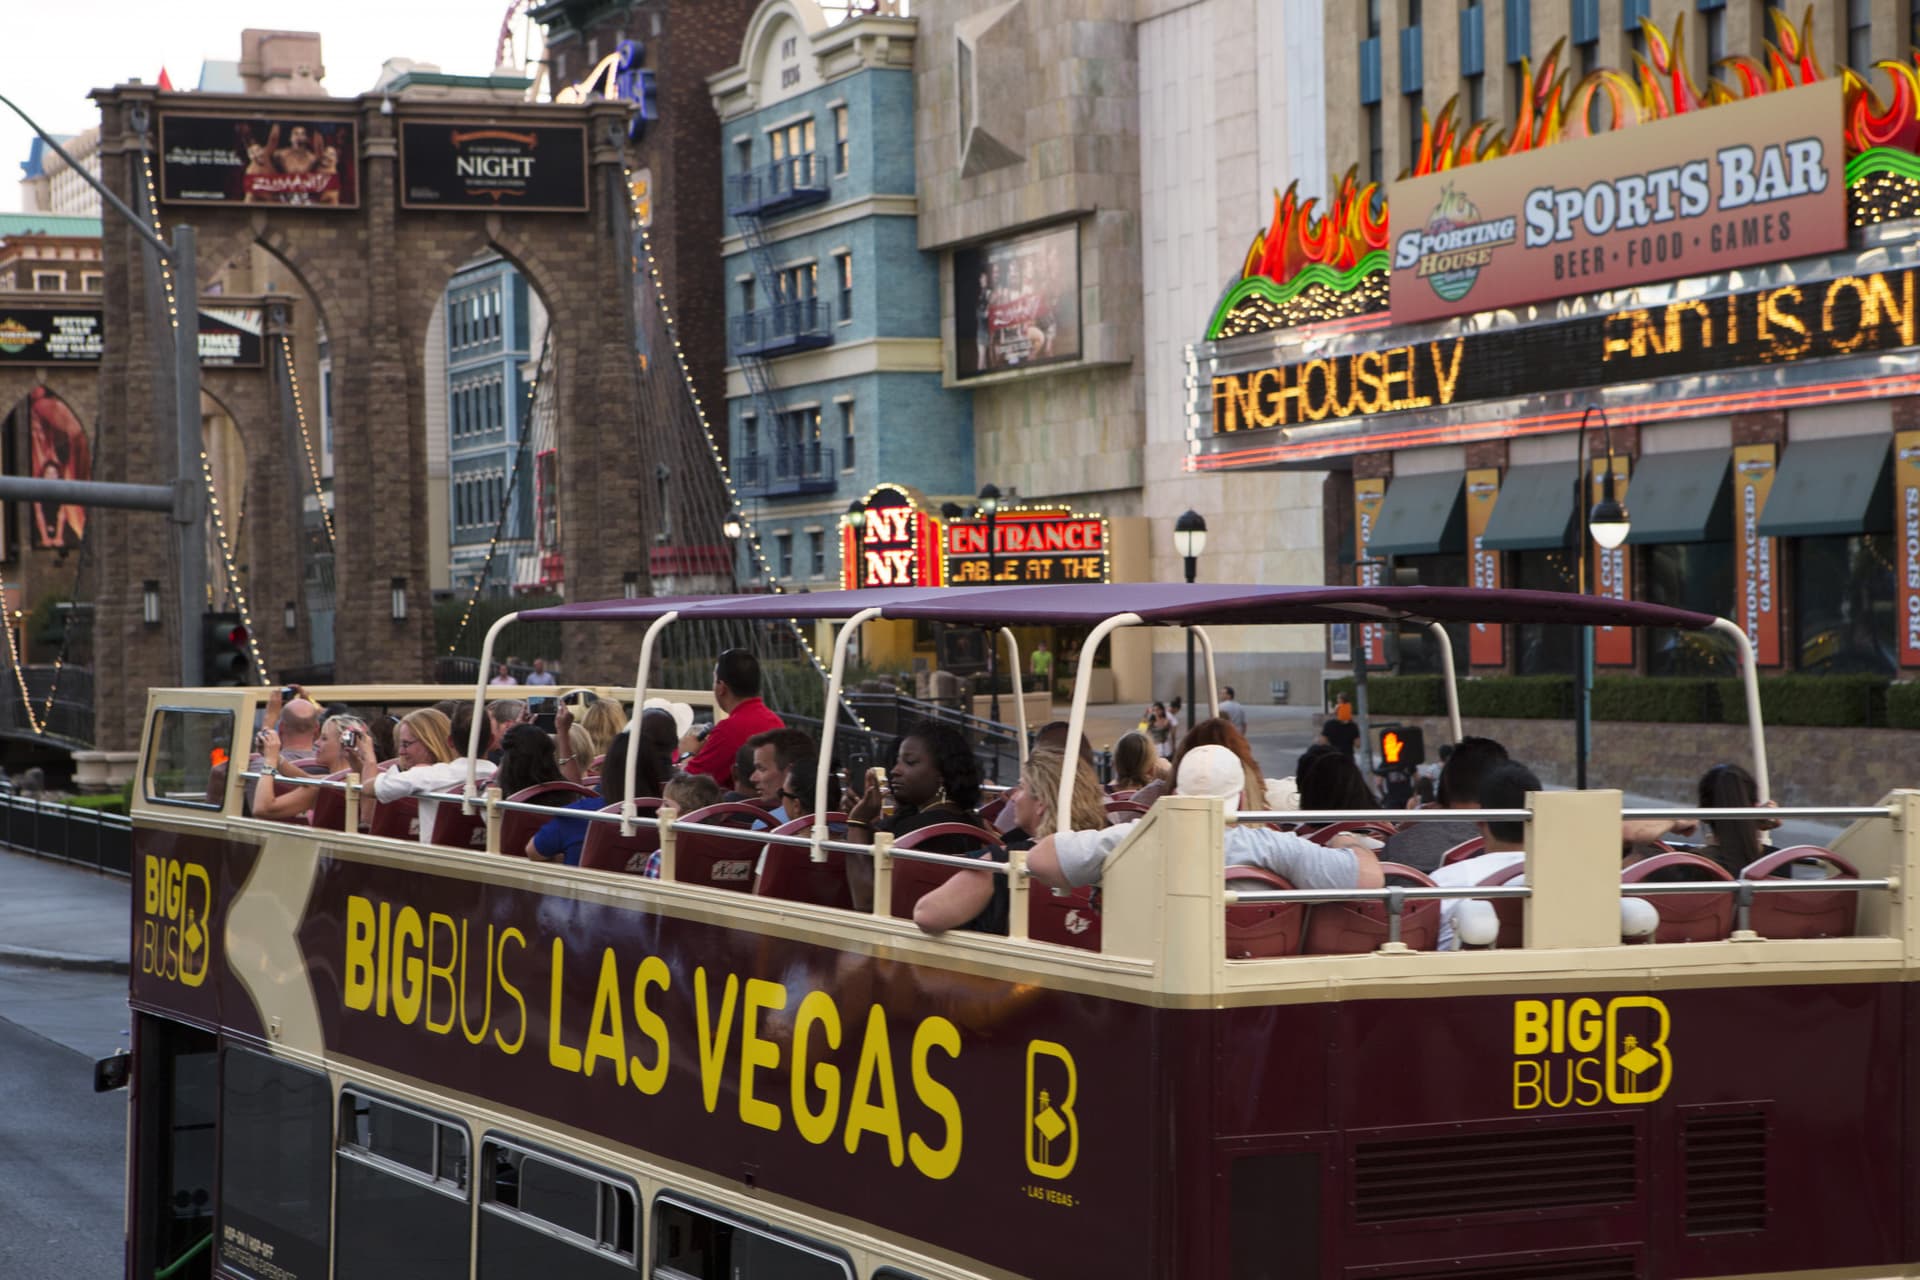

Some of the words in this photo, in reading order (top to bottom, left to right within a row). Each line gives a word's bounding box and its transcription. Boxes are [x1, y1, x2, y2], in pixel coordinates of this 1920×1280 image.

[456, 155, 536, 177] NIGHT
[1523, 159, 1709, 249] SPORTS
[1717, 136, 1828, 211] BAR
[1394, 216, 1516, 270] SPORTING
[1416, 249, 1493, 278] HOUSE
[1553, 246, 1605, 281] BEER
[1628, 231, 1684, 267] FOOD
[1710, 210, 1791, 253] GAMES
[864, 505, 913, 545] NY
[950, 520, 1102, 553] ENTRANCE
[1905, 487, 1920, 590] SPORTS
[865, 549, 914, 585] NY
[1025, 558, 1053, 580] AT
[1061, 557, 1102, 581] THE
[1908, 595, 1920, 650] PRO
[145, 854, 182, 921] BIG
[142, 919, 179, 981] BUS
[1514, 997, 1604, 1055] BIG
[549, 936, 671, 1095] LAS
[694, 966, 964, 1180] VEGAS
[1513, 1057, 1603, 1109] BUS
